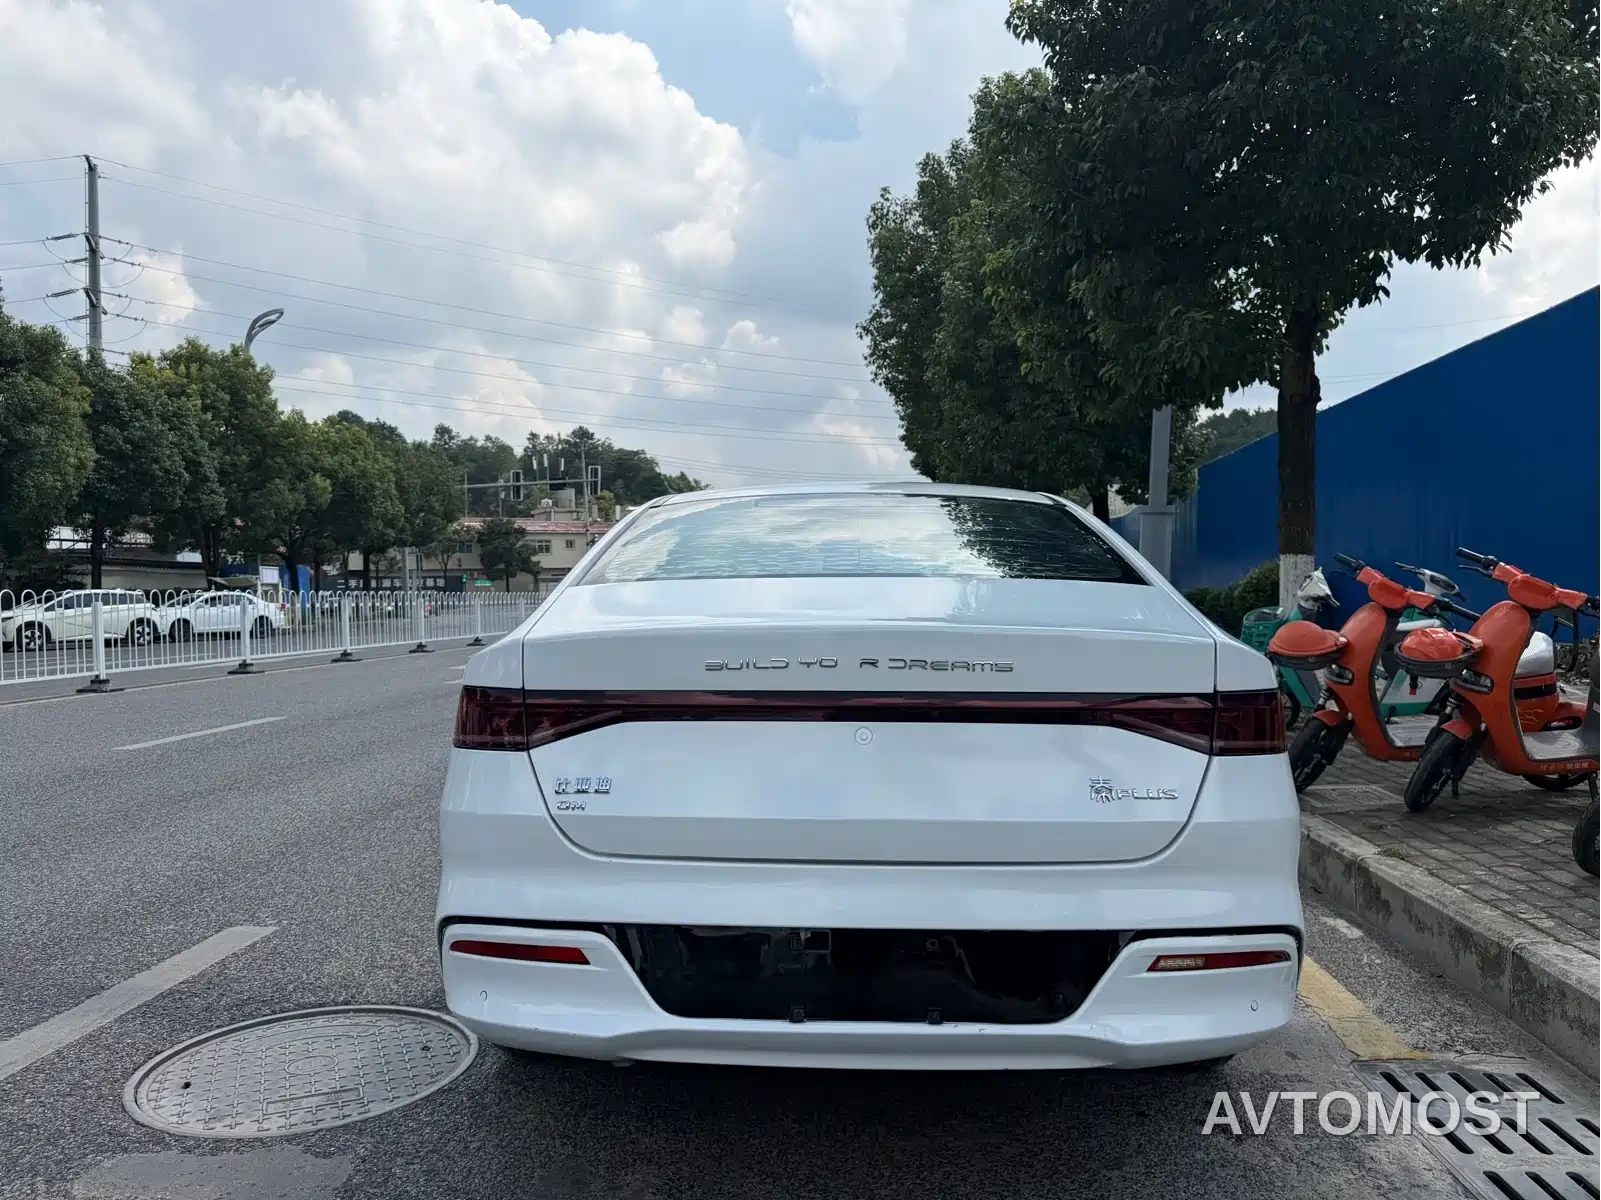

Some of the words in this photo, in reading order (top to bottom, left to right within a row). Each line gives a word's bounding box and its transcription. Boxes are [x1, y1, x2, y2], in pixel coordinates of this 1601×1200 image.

[705, 658, 789, 671] BUILD
[888, 658, 1014, 672] DREAMS
[555, 777, 612, 794] 比亚迪
[557, 801, 587, 811] DM
